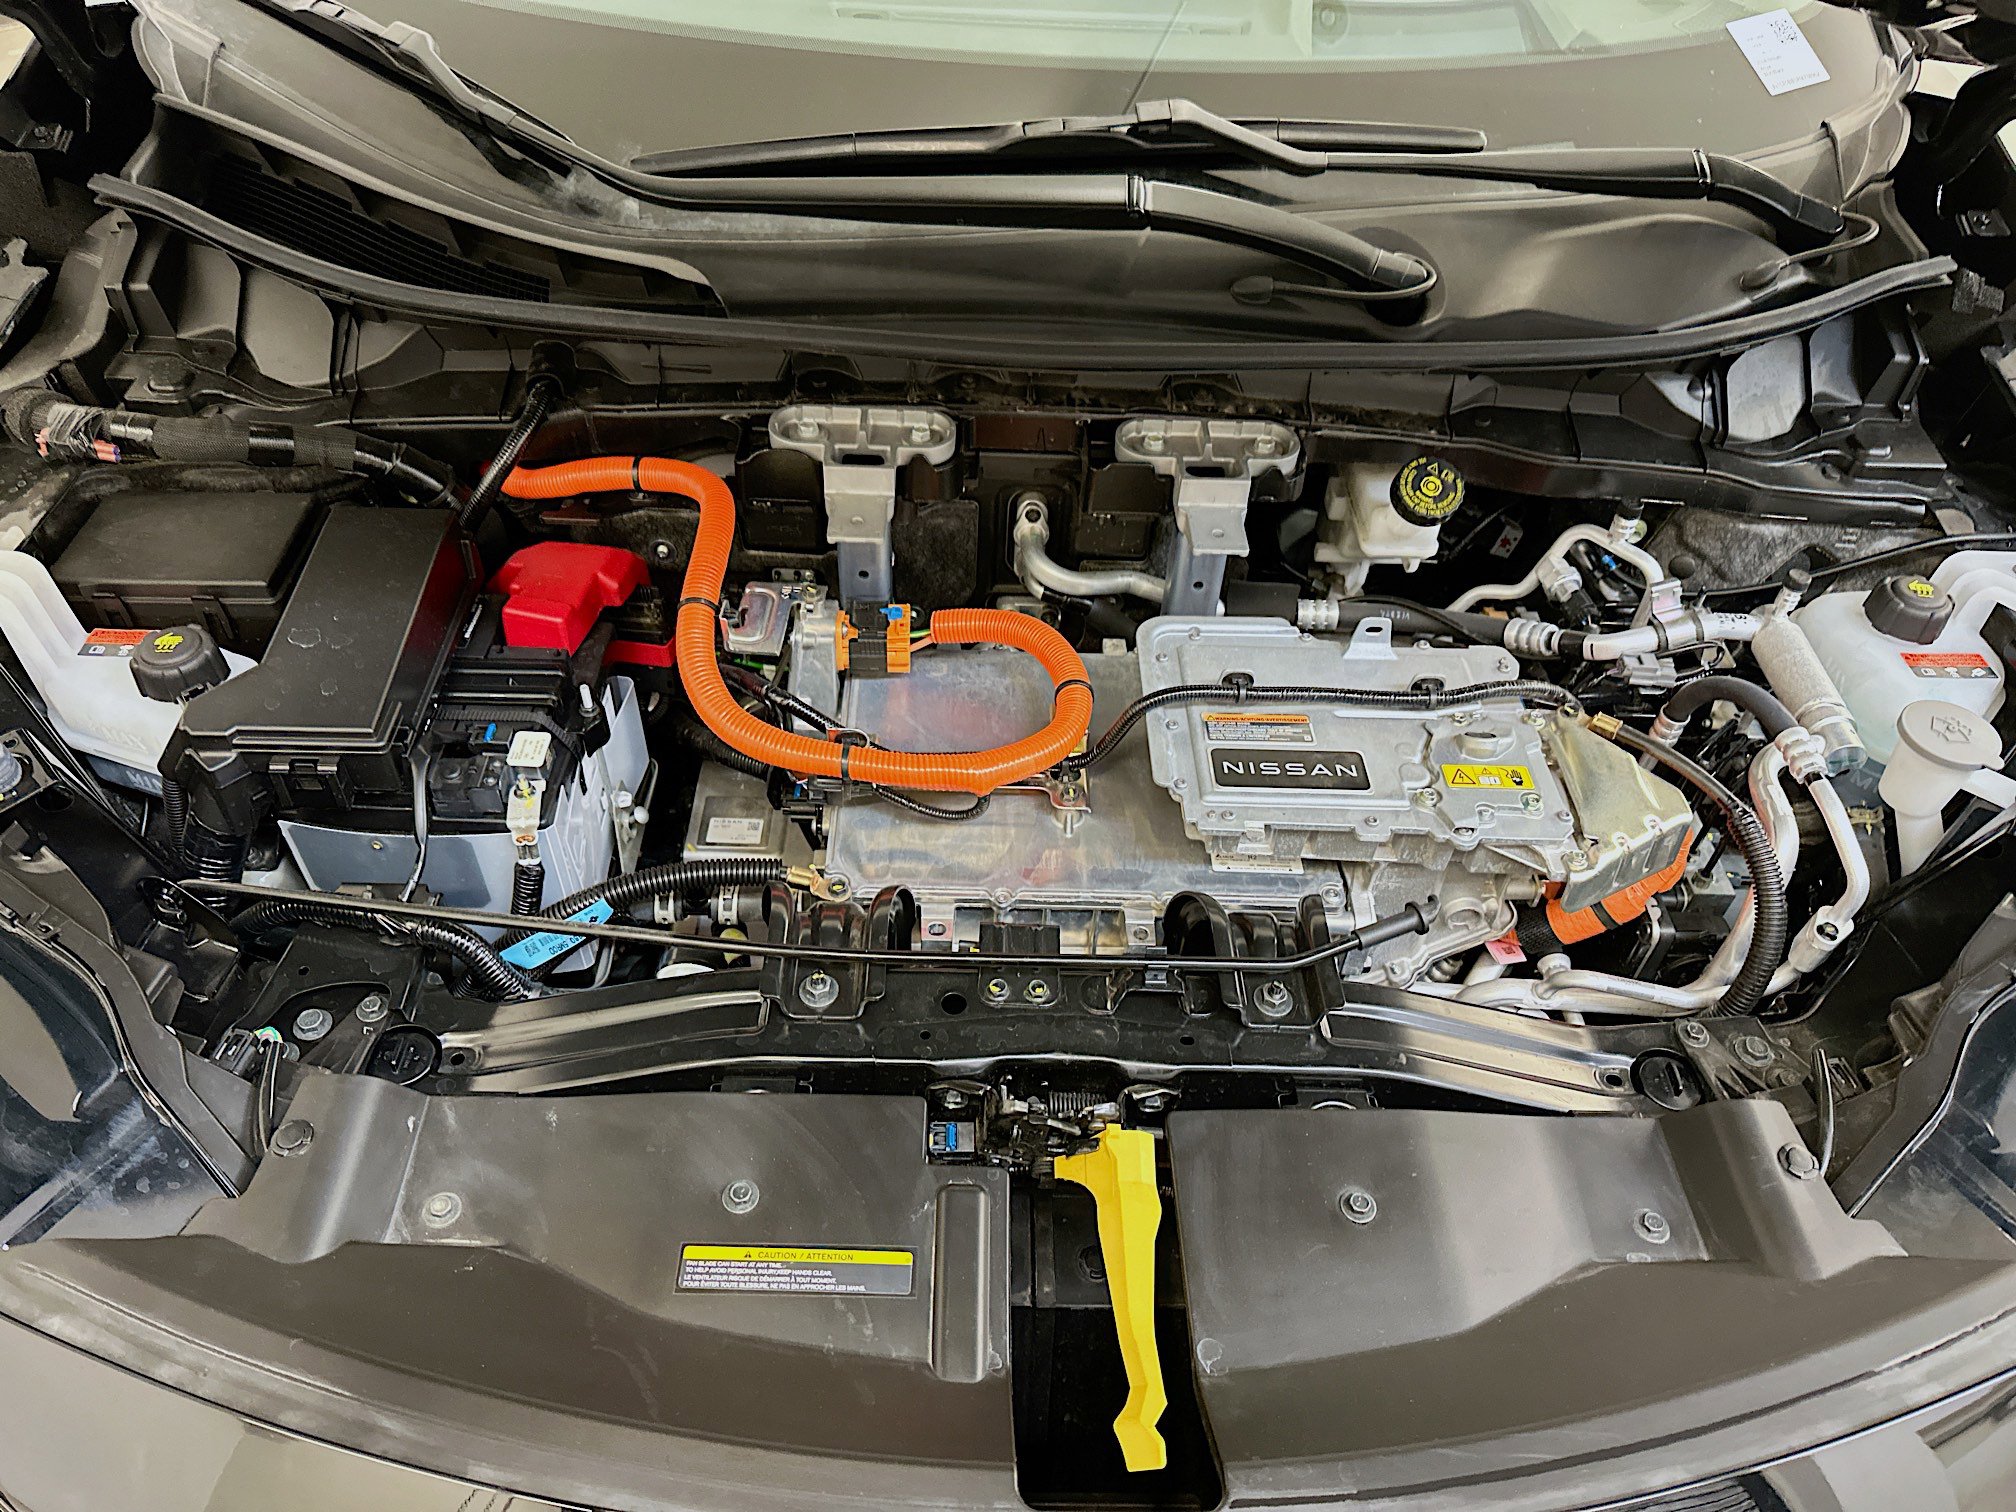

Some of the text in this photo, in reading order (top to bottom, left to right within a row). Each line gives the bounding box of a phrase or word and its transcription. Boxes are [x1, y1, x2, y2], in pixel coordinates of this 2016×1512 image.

[1222, 761, 1358, 777] NISSAN
[758, 1251, 796, 1259] CAUTION
[806, 1252, 854, 1260] ATTENTION
